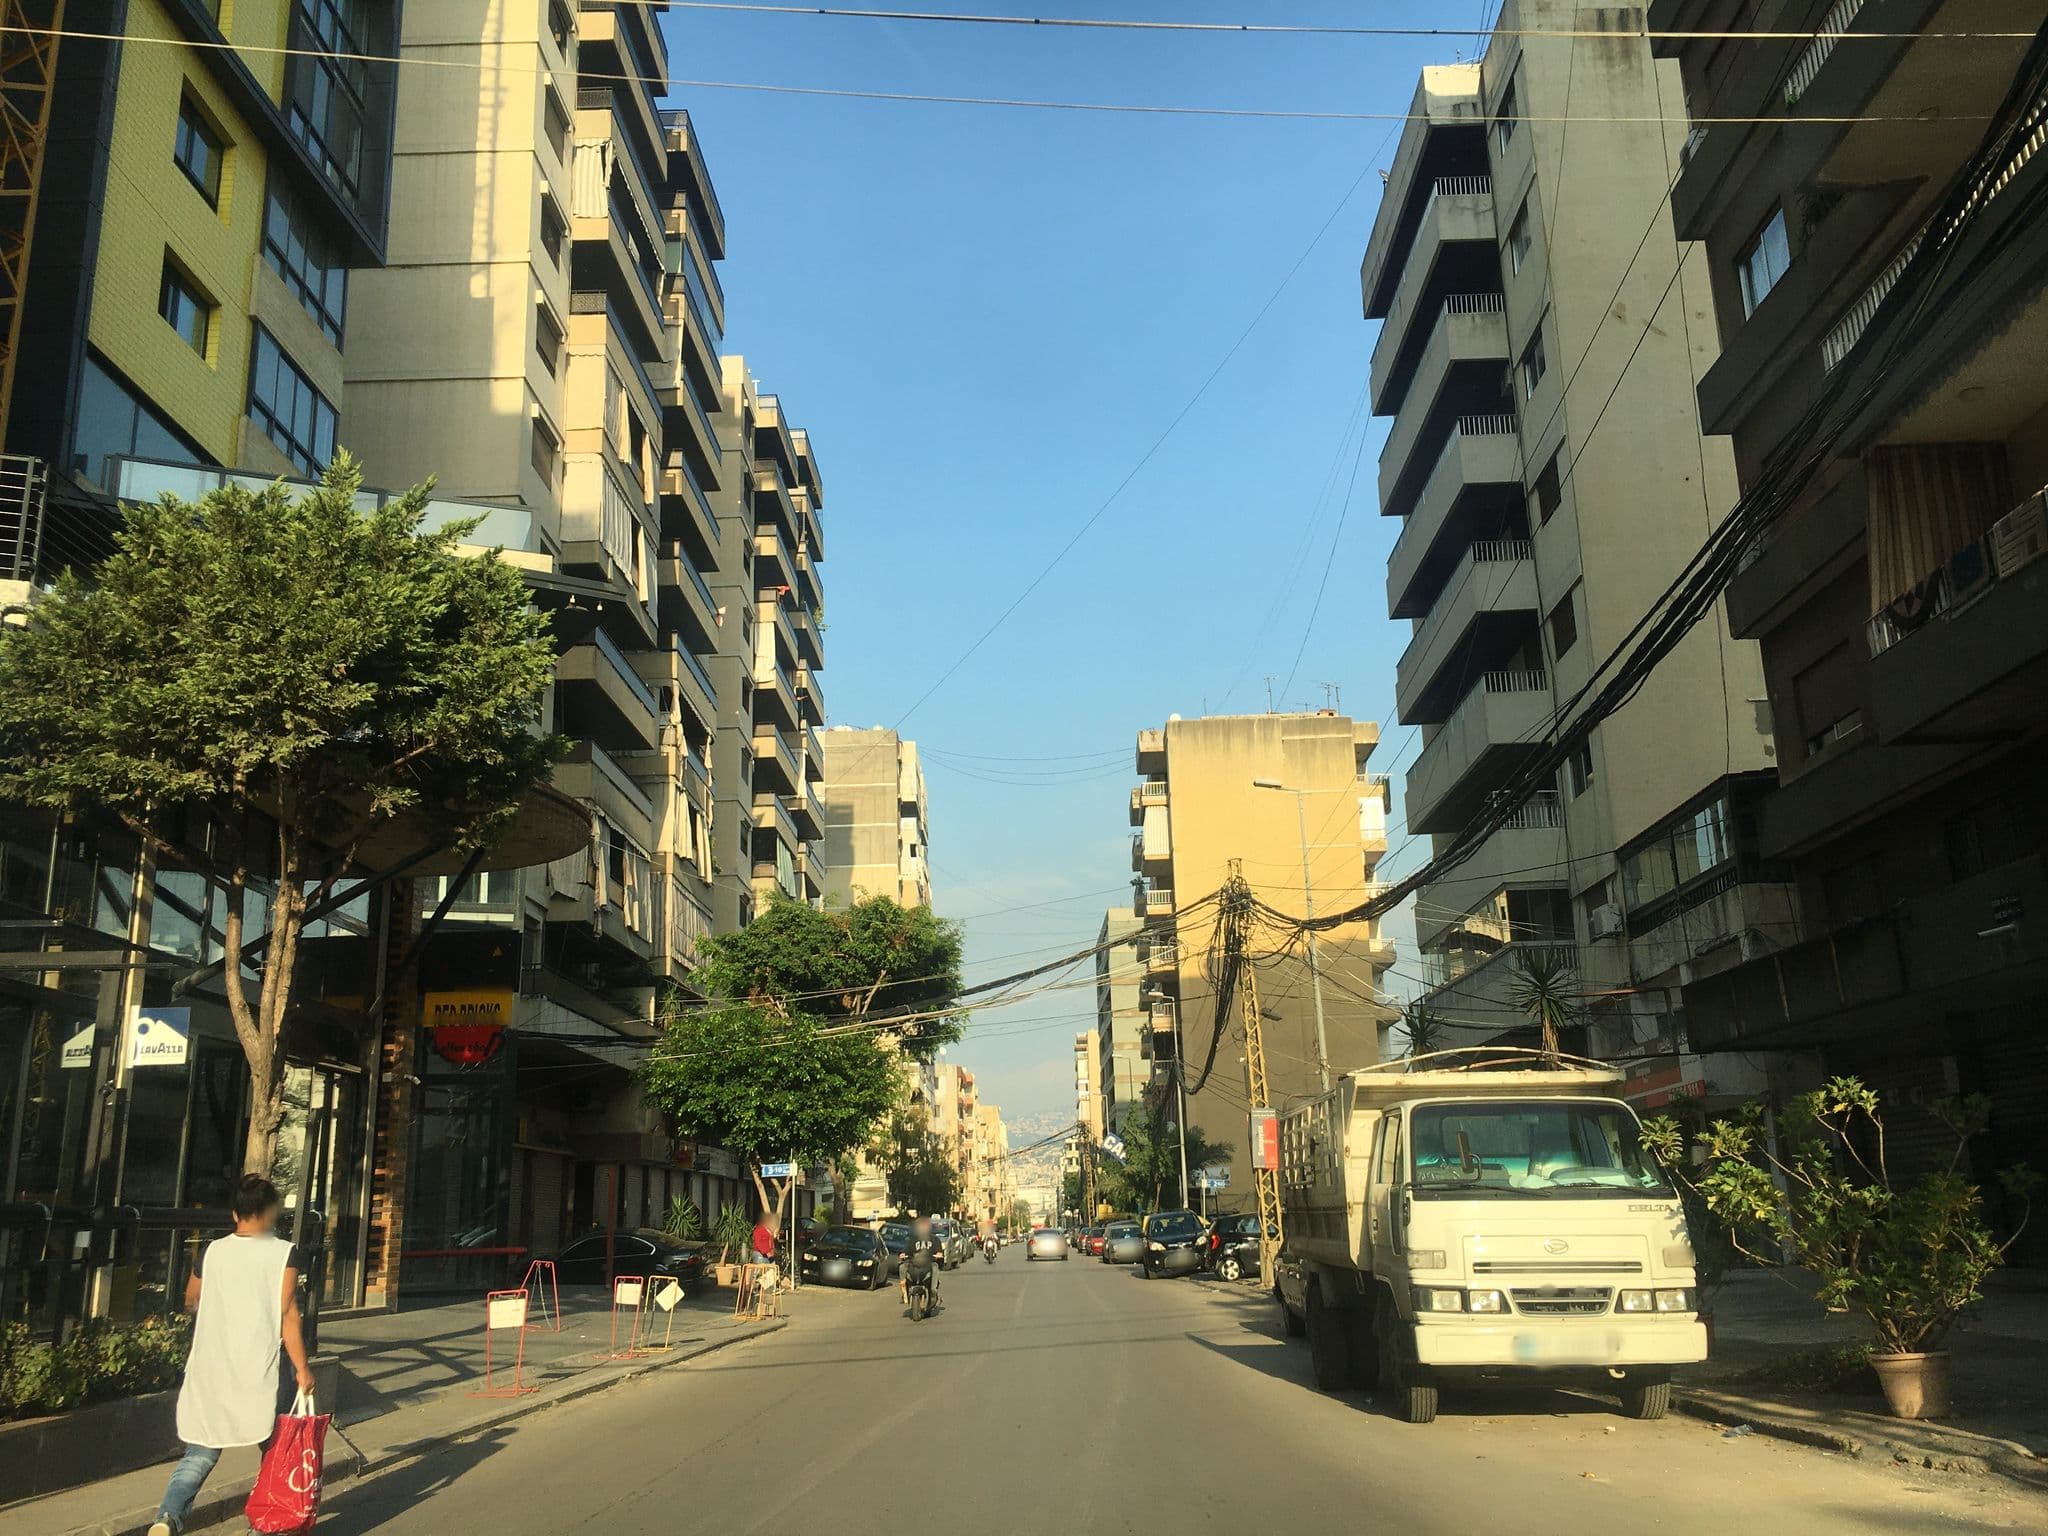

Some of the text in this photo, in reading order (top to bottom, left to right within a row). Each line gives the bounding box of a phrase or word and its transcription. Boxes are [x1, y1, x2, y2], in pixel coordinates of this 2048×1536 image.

[140, 1042, 183, 1054] LAVAZZA
[1628, 1204, 1673, 1212] DELTA
[915, 1240, 933, 1250] GAP
